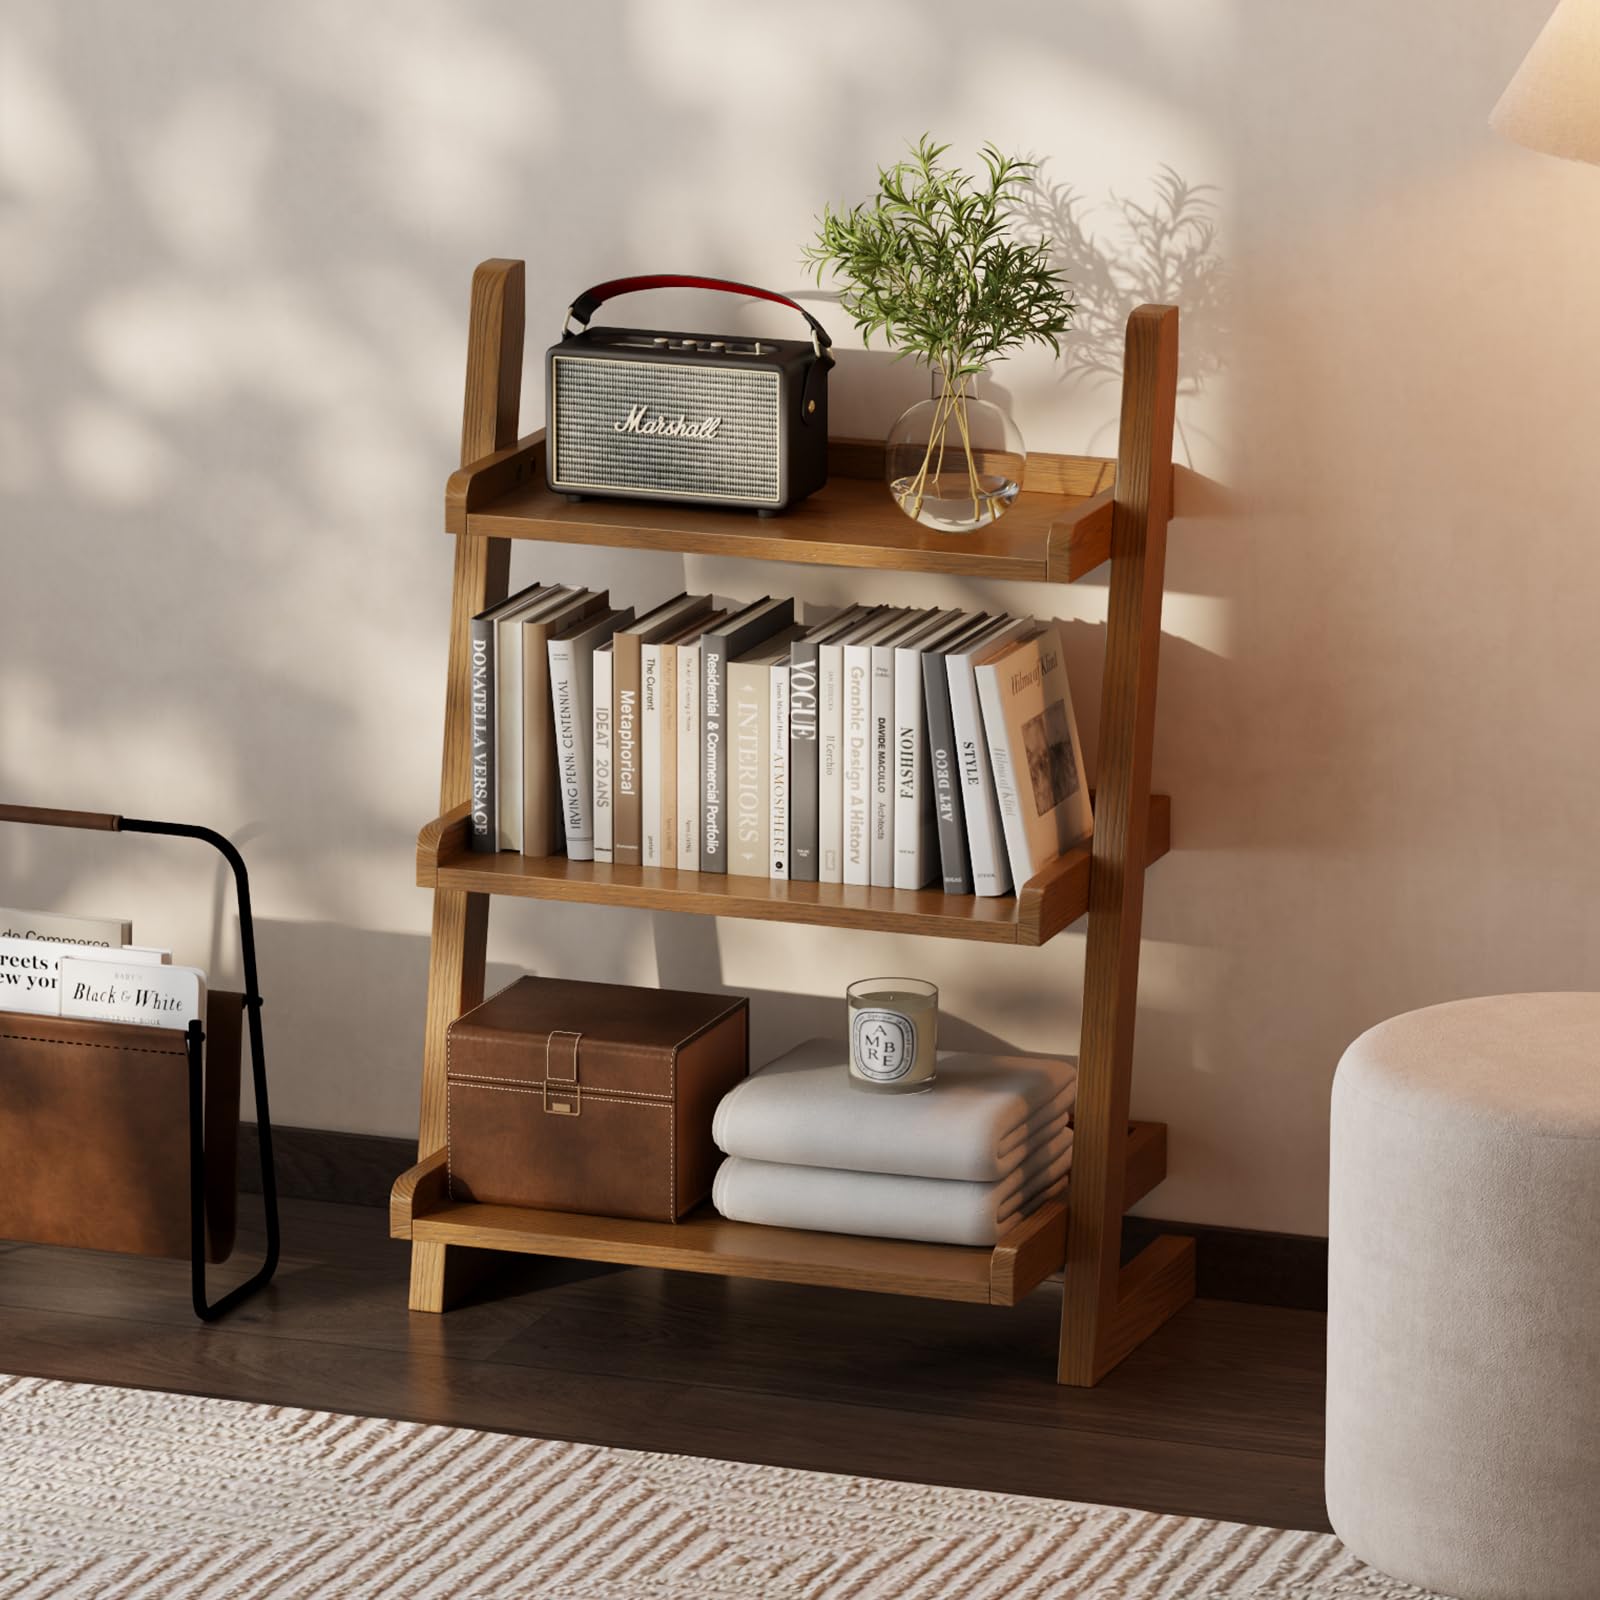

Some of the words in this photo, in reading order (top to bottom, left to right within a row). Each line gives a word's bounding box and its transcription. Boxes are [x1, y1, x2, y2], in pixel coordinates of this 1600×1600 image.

[615, 404, 721, 439] Marshall
[646, 658, 655, 675] The
[707, 653, 720, 717] Residential
[472, 640, 487, 748] DONATELLA
[557, 680, 574, 748] CENTENNIAL
[646, 676, 655, 711] Current
[790, 659, 816, 740] VOGUE
[849, 666, 865, 731] Graphic
[596, 707, 609, 749] IDEAT
[619, 690, 635, 795] Metaphorical
[707, 721, 719, 731] &
[877, 717, 886, 749] DAVIDE
[564, 753, 577, 784] PENN:
[596, 760, 609, 778] 20
[706, 732, 719, 803] Commercial
[737, 703, 759, 843] INTERIORS
[846, 738, 864, 791] Design
[877, 750, 886, 793] MACULLO
[900, 727, 914, 799] FASHION
[935, 750, 950, 788] DECO
[963, 742, 979, 786] STYLE
[474, 753, 488, 835] VERSACE
[567, 789, 582, 829] IRVING
[596, 780, 609, 808] ANS
[939, 790, 953, 822] ART
[706, 805, 719, 855] Portfolio
[849, 809, 865, 864] History
[73, 983, 118, 1004] Black
[121, 989, 131, 1001] &
[135, 989, 183, 1012] White
